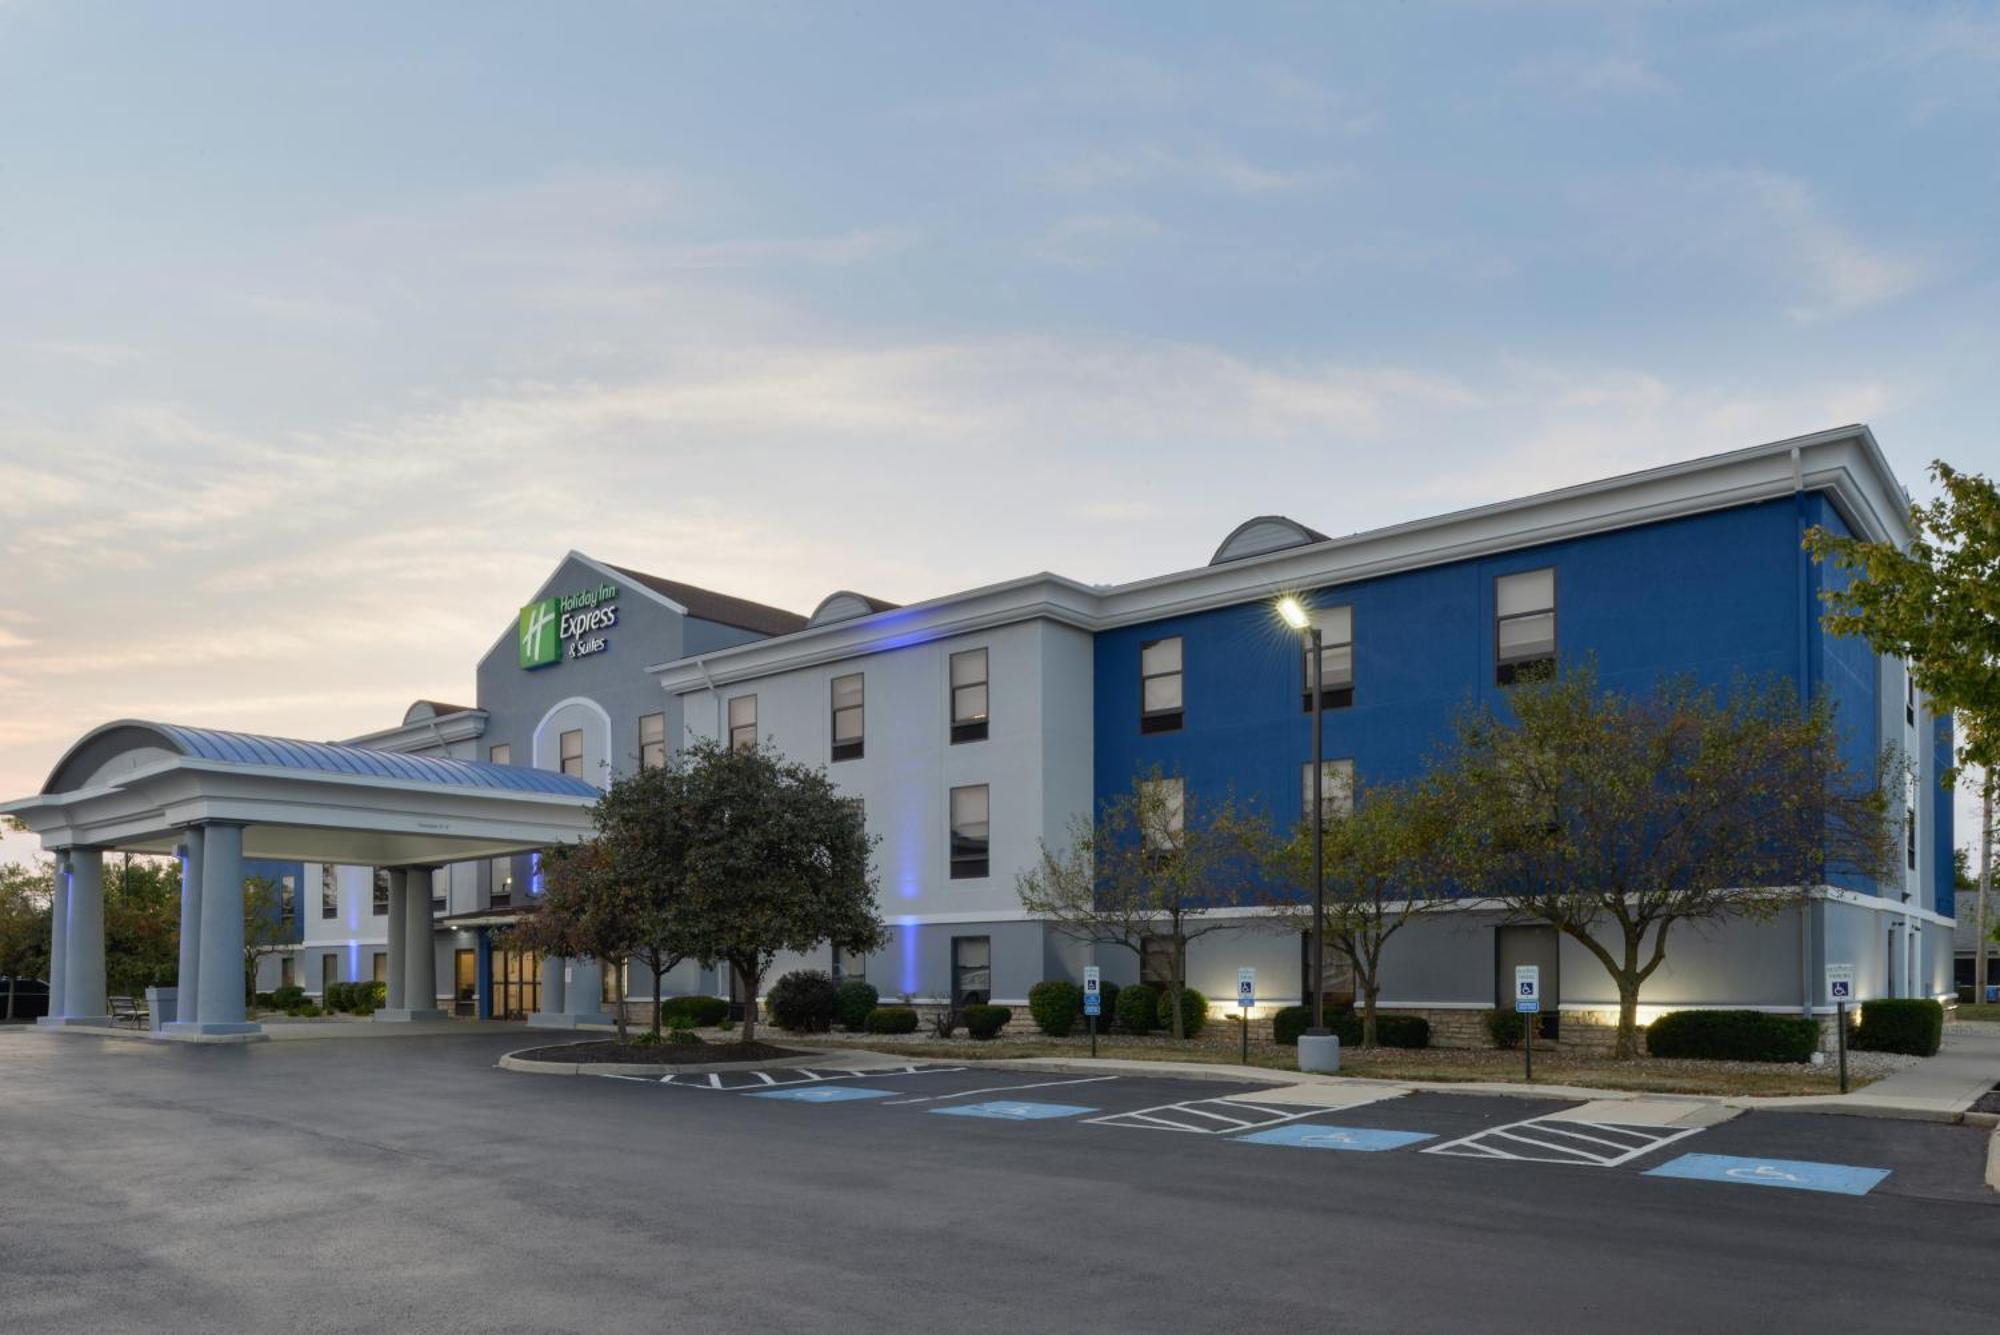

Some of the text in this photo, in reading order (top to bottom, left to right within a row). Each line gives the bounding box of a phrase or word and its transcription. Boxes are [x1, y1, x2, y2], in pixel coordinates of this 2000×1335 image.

[560, 583, 616, 612] Holiday Inn
[560, 606, 615, 640] Express
[568, 637, 605, 658] & Suites
